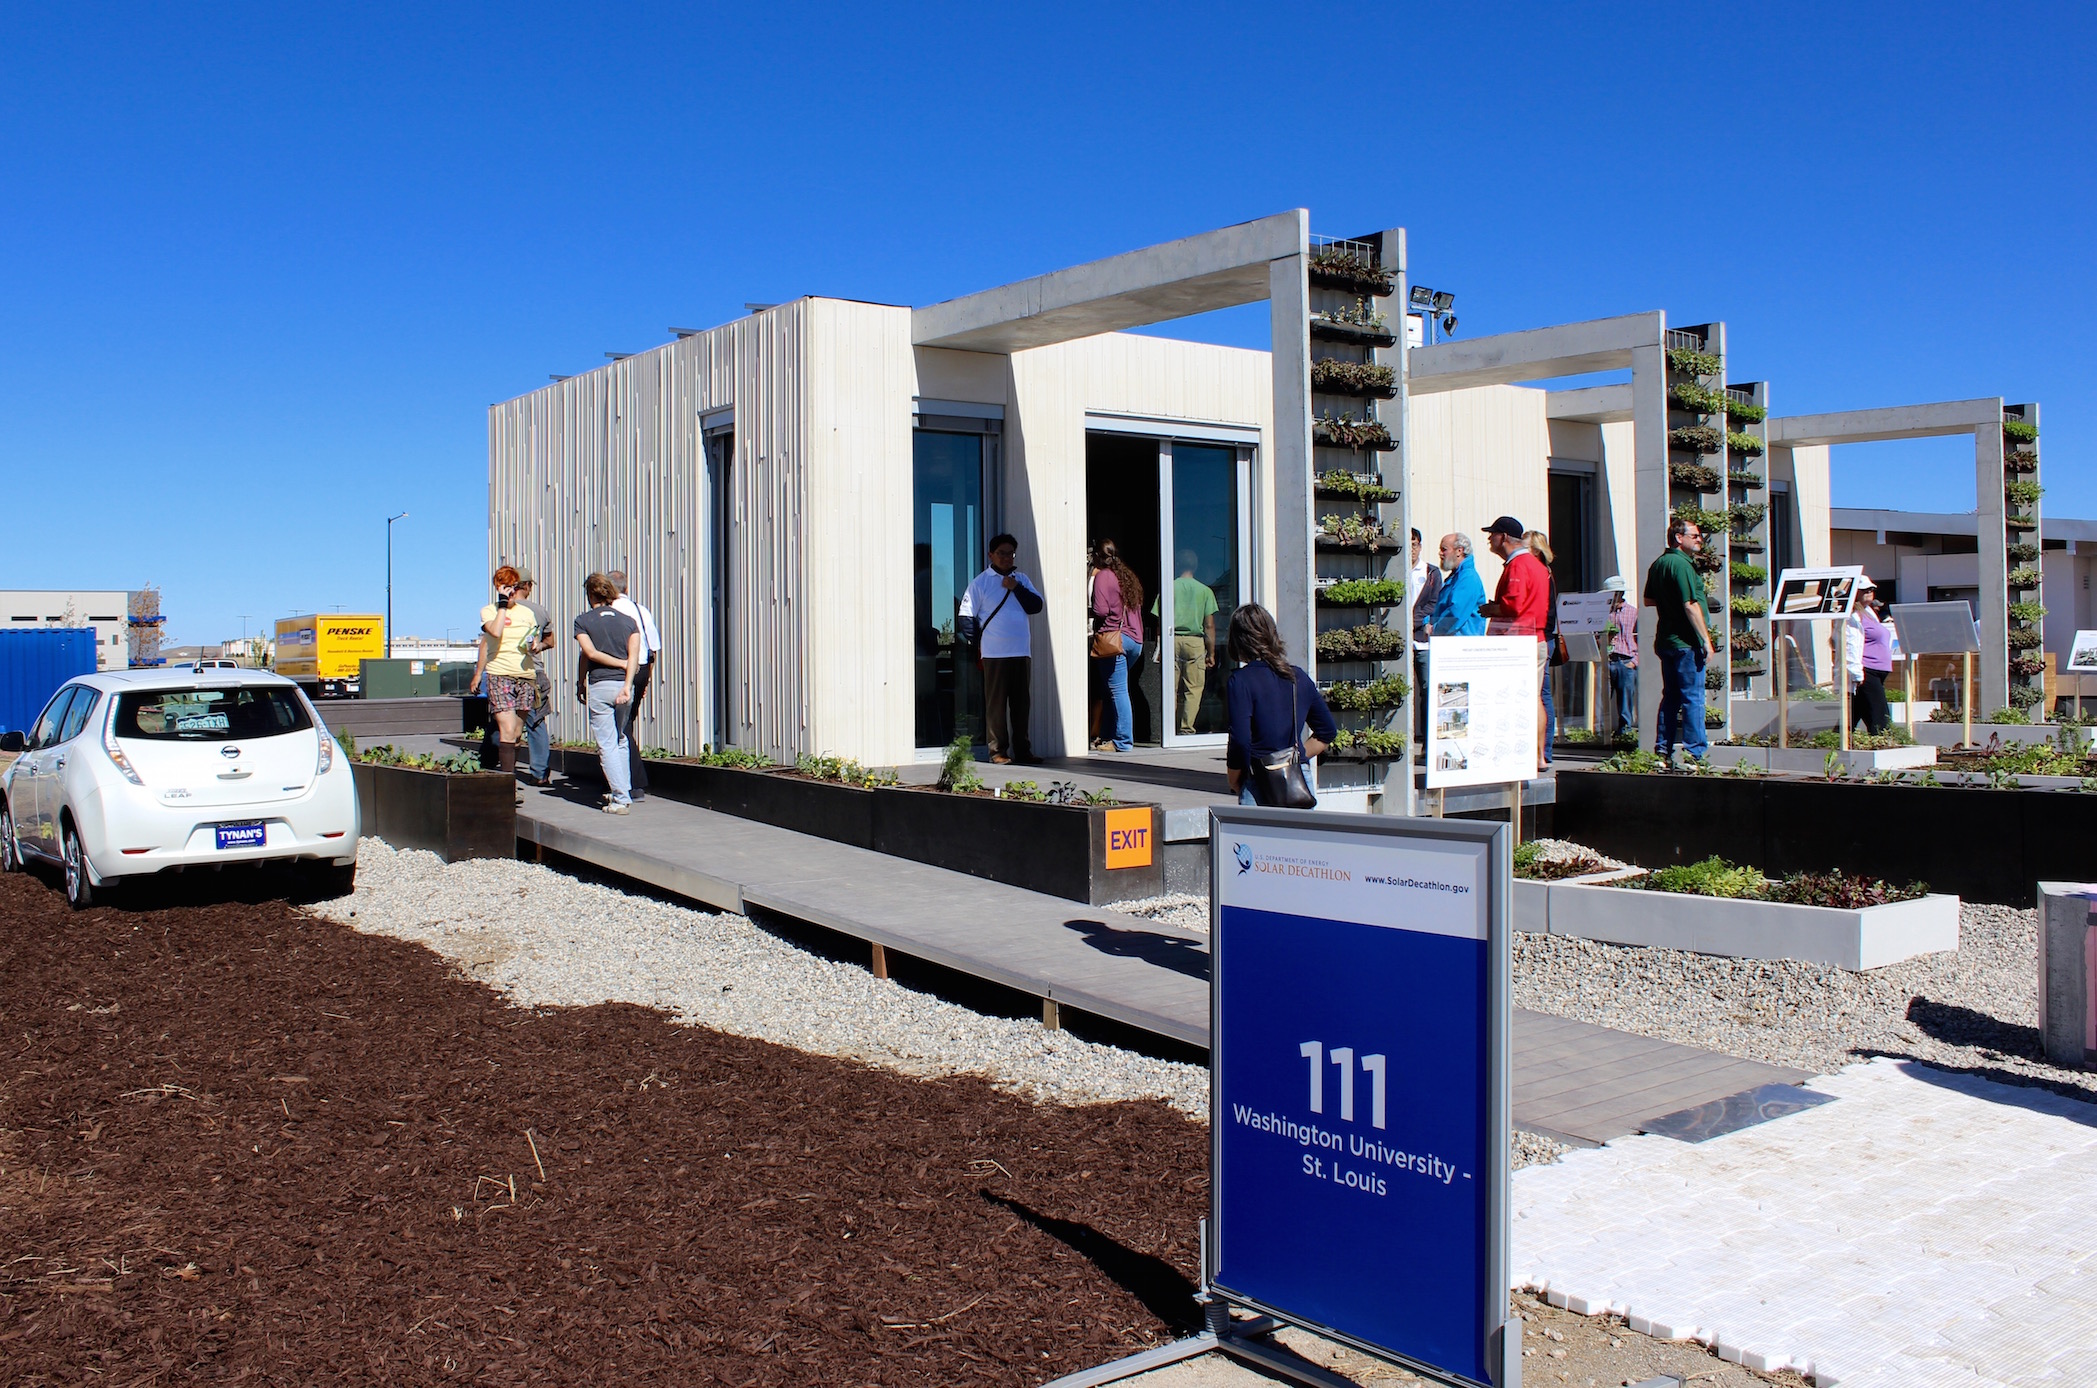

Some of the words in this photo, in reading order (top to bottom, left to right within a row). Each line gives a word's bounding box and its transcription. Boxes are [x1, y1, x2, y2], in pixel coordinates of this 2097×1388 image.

[327, 627, 374, 636] PENSKE
[219, 829, 263, 840] TYNAN'S
[1111, 828, 1148, 851] EXIT
[1265, 855, 1298, 864] DEPARTMENT
[1254, 861, 1285, 875] SOLAR
[1288, 864, 1351, 881] DECATHLON
[1364, 875, 1470, 894] www.SolarDecathlon.gov
[1299, 1040, 1387, 1131] 111
[1233, 1103, 1343, 1152] Washington
[1350, 1134, 1456, 1185] University
[1302, 1154, 1327, 1180] St.
[1333, 1162, 1388, 1197] Louis
